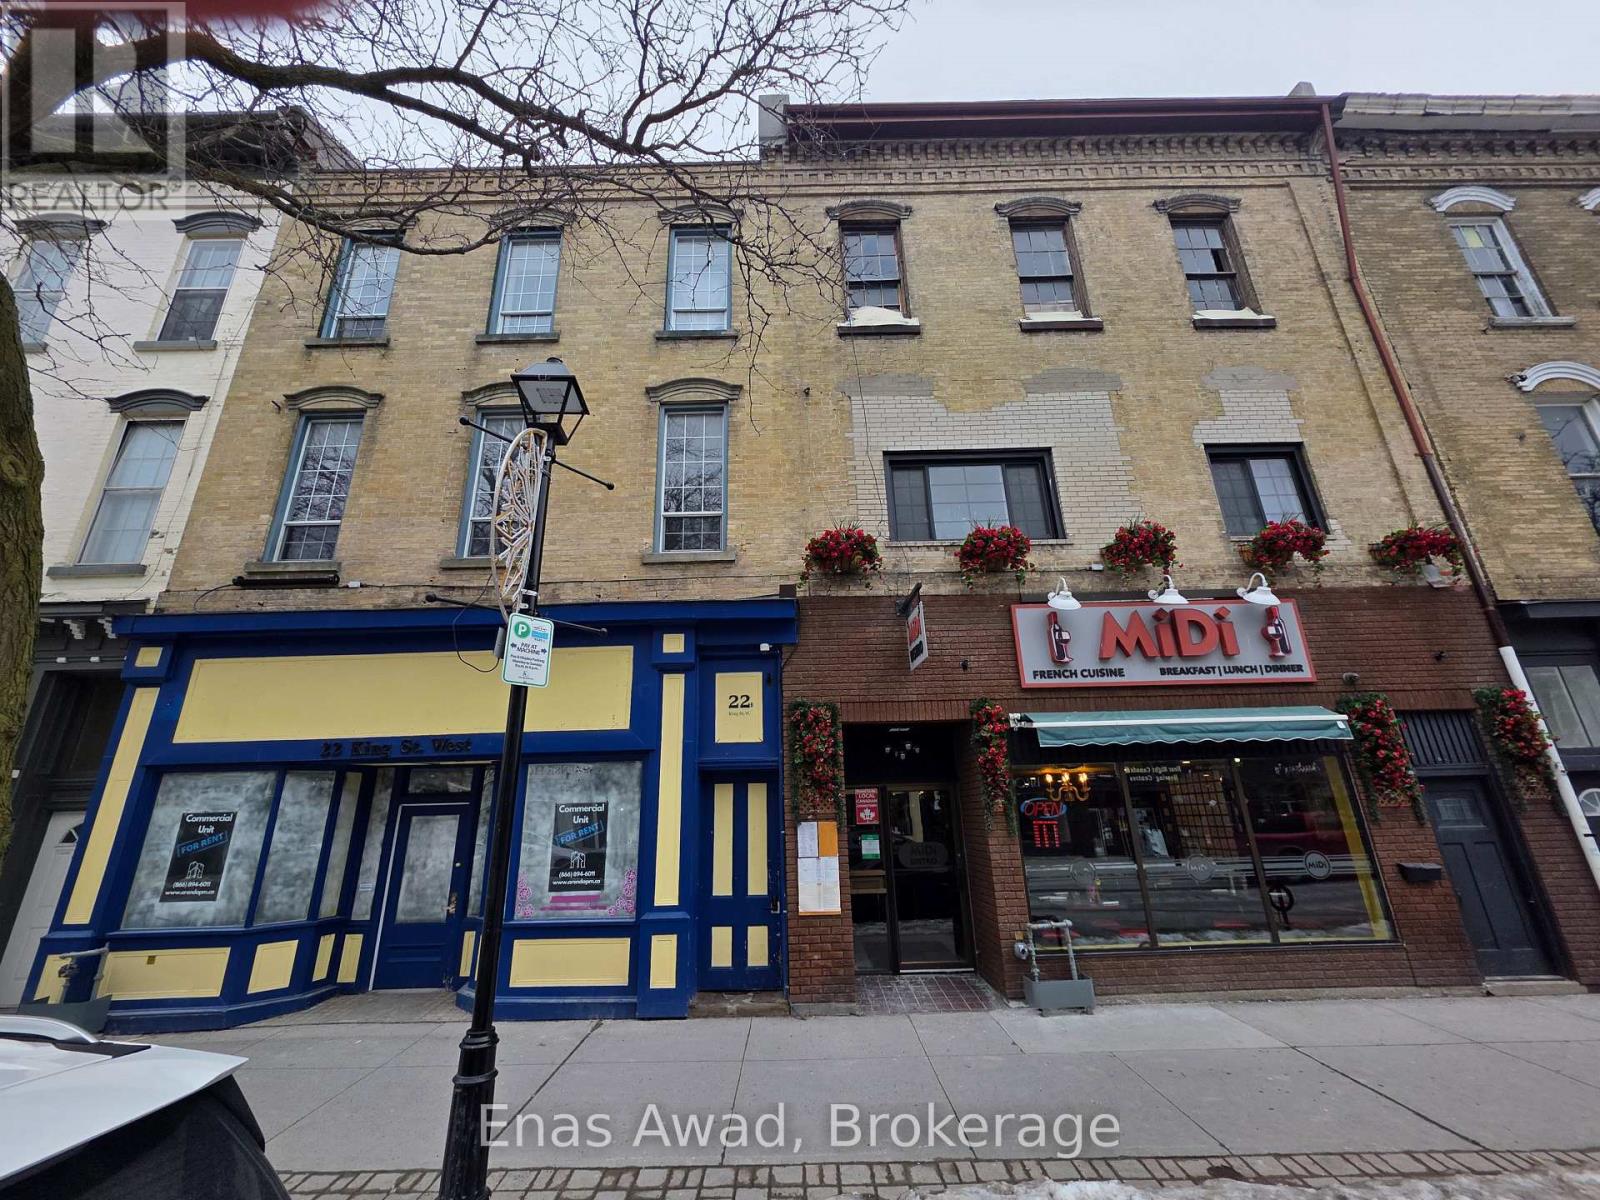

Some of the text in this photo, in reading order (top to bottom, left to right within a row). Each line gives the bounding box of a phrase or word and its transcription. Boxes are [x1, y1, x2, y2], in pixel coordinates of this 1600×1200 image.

[1099, 606, 1241, 660] MiDi
[1033, 668, 1125, 680] FRENCH CUISINE
[1159, 663, 1304, 676] BREAKFAST LUNCH DINNER
[352, 741, 392, 760] King
[432, 738, 472, 752] West
[559, 803, 605, 813] Commercial
[186, 814, 233, 823] Commercial
[573, 815, 589, 824] Unit
[198, 825, 215, 834] Unit
[560, 822, 599, 843] FOR RENT
[181, 832, 223, 854] FOR RENT
